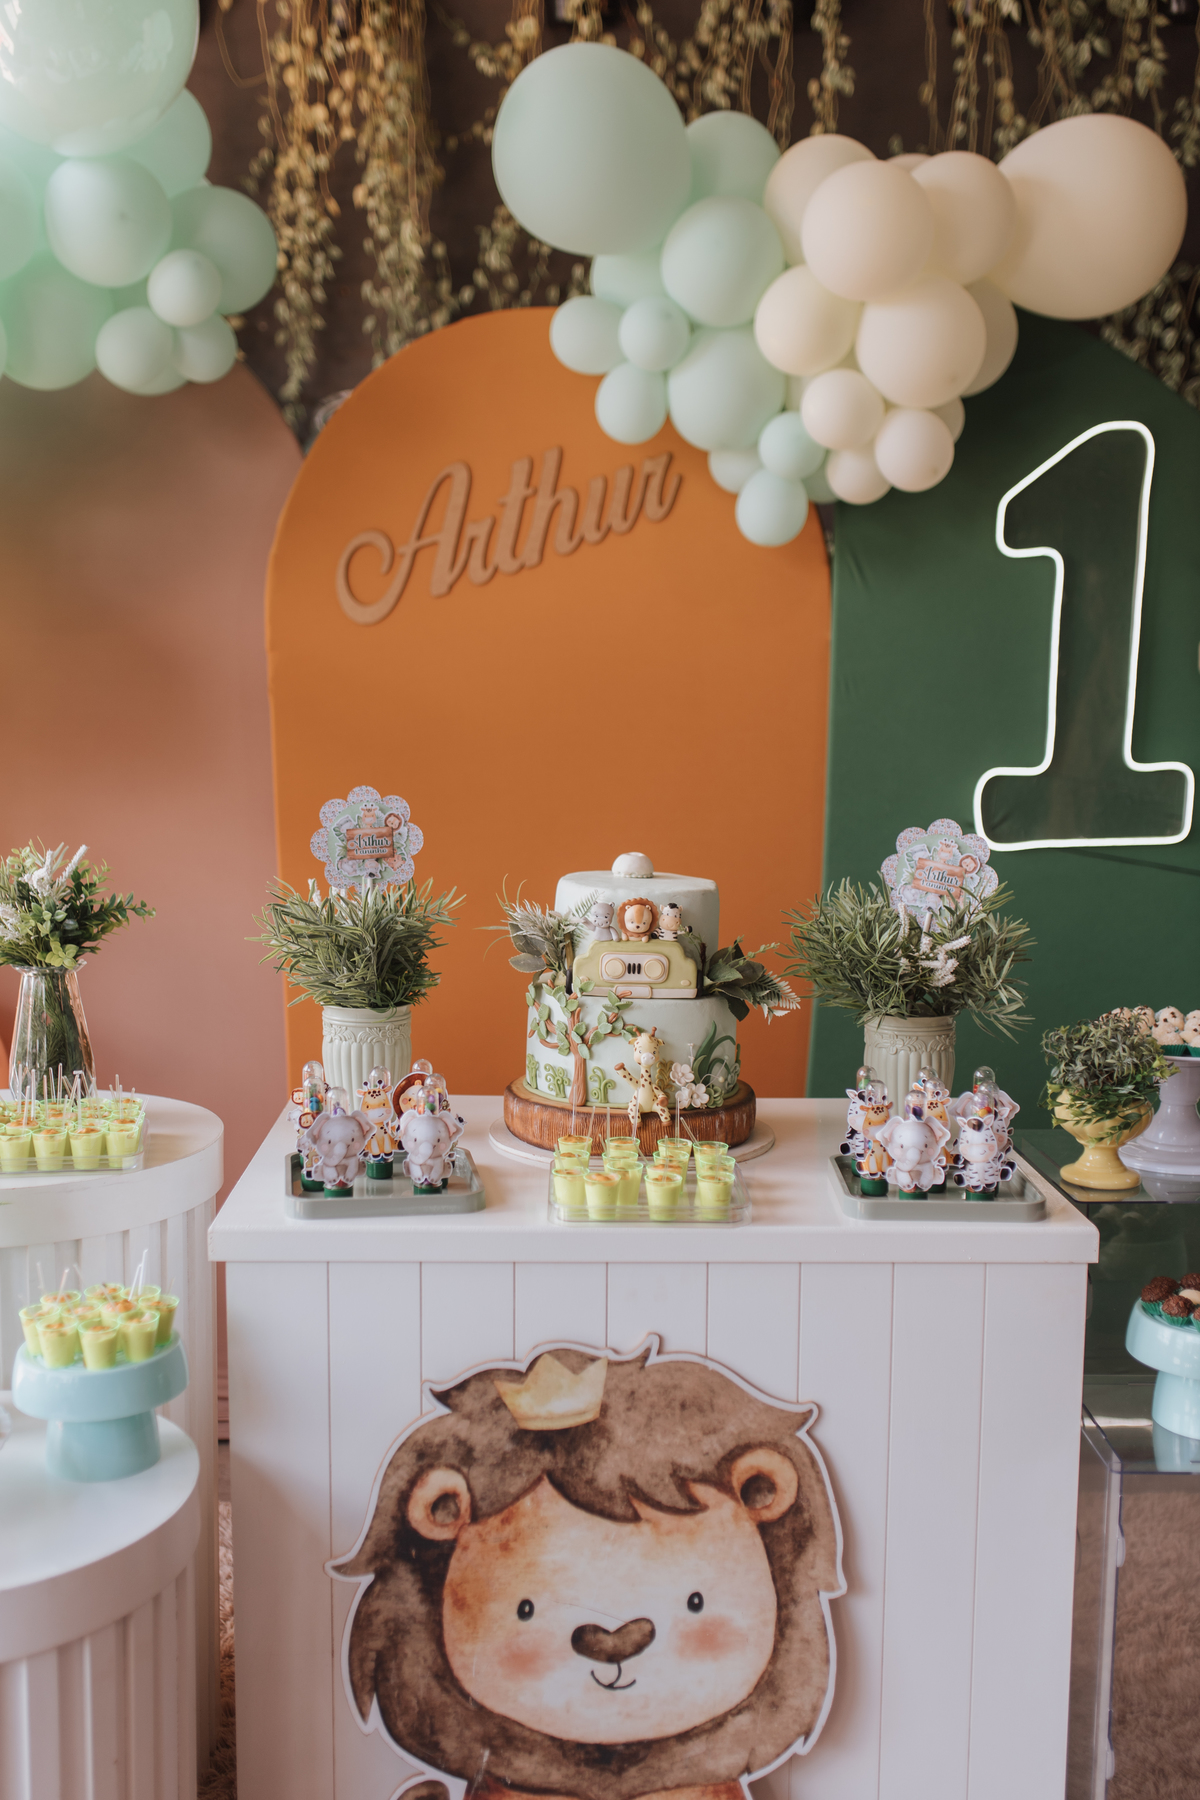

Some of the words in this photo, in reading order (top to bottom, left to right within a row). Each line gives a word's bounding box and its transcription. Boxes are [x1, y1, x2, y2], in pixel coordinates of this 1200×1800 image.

[335, 445, 683, 626] Arthur
[973, 420, 1195, 852] 1
[347, 833, 391, 849] Arthur
[916, 865, 961, 886] Arthur
